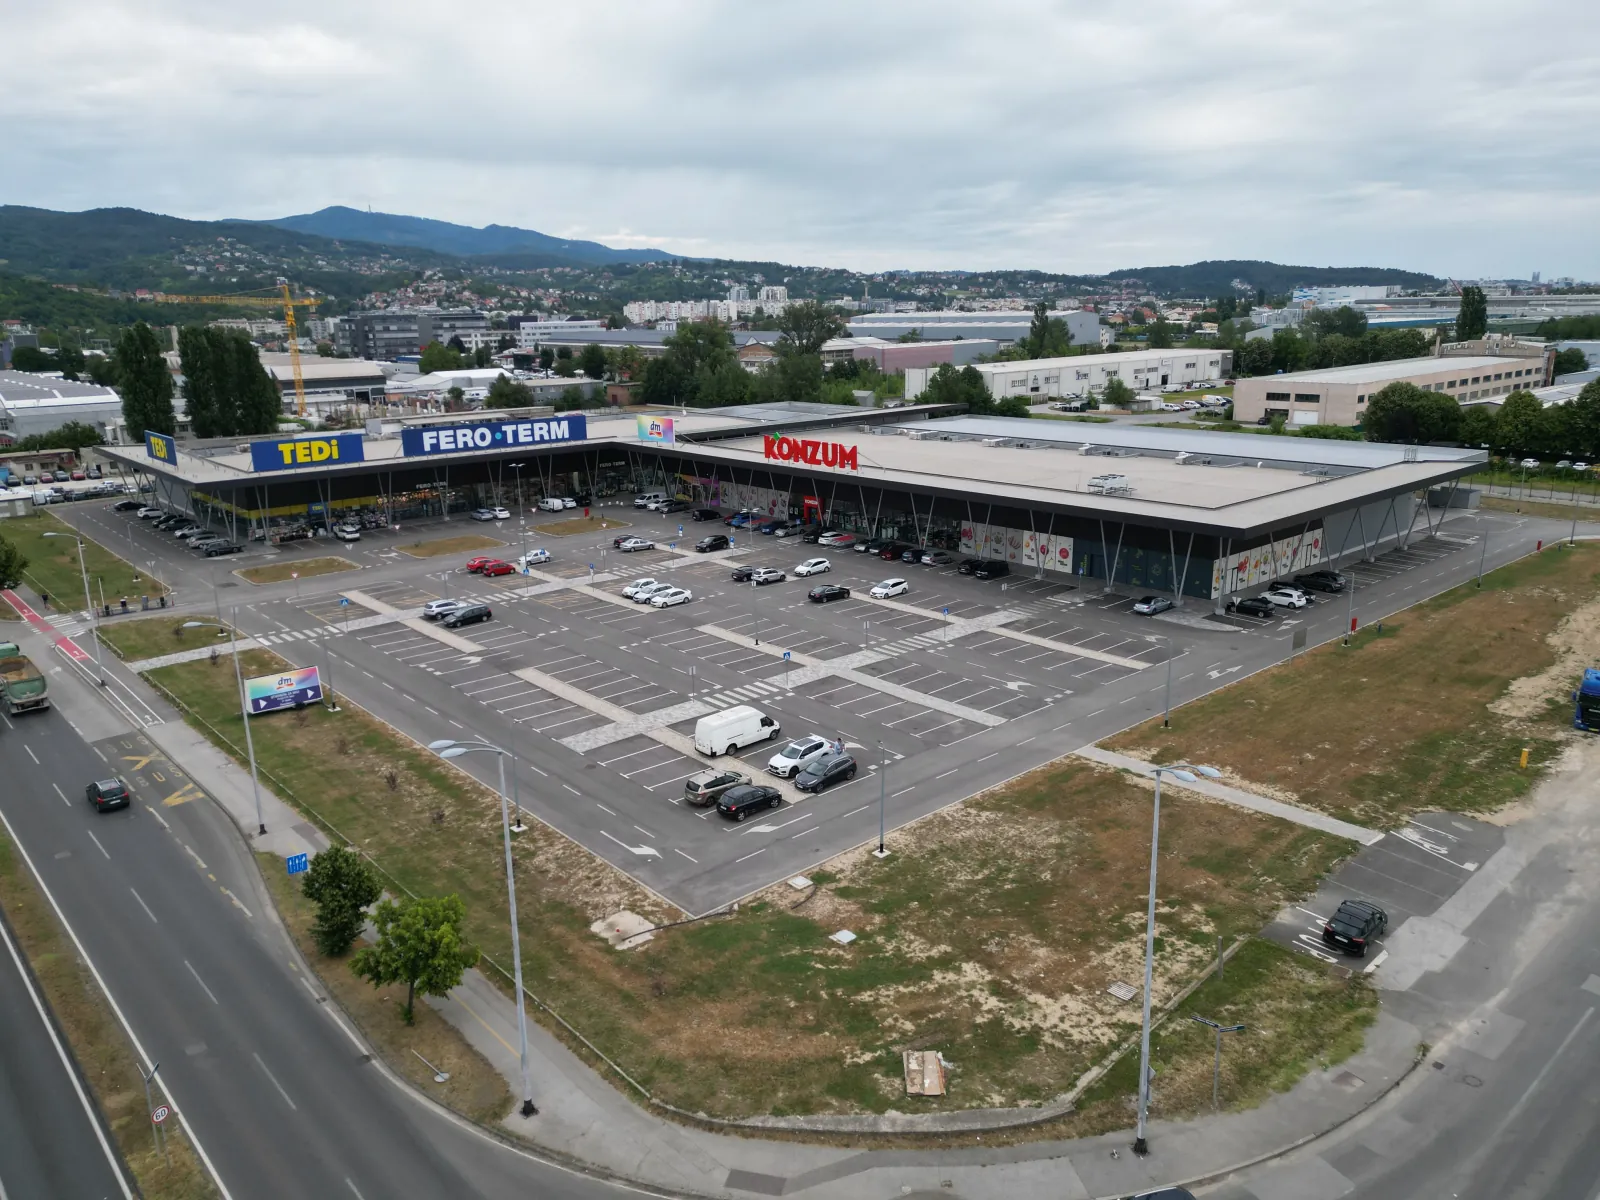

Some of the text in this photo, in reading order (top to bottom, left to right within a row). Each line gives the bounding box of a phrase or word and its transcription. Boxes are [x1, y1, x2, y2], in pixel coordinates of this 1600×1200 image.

[422, 420, 570, 452] FERO TERM
[649, 421, 661, 432] dm
[149, 436, 168, 459] TEDi
[277, 439, 340, 465] TEDi
[763, 434, 858, 470] KONZUM
[277, 676, 292, 686] dm
[135, 763, 184, 788] BUS
[155, 1109, 166, 1120] 60
